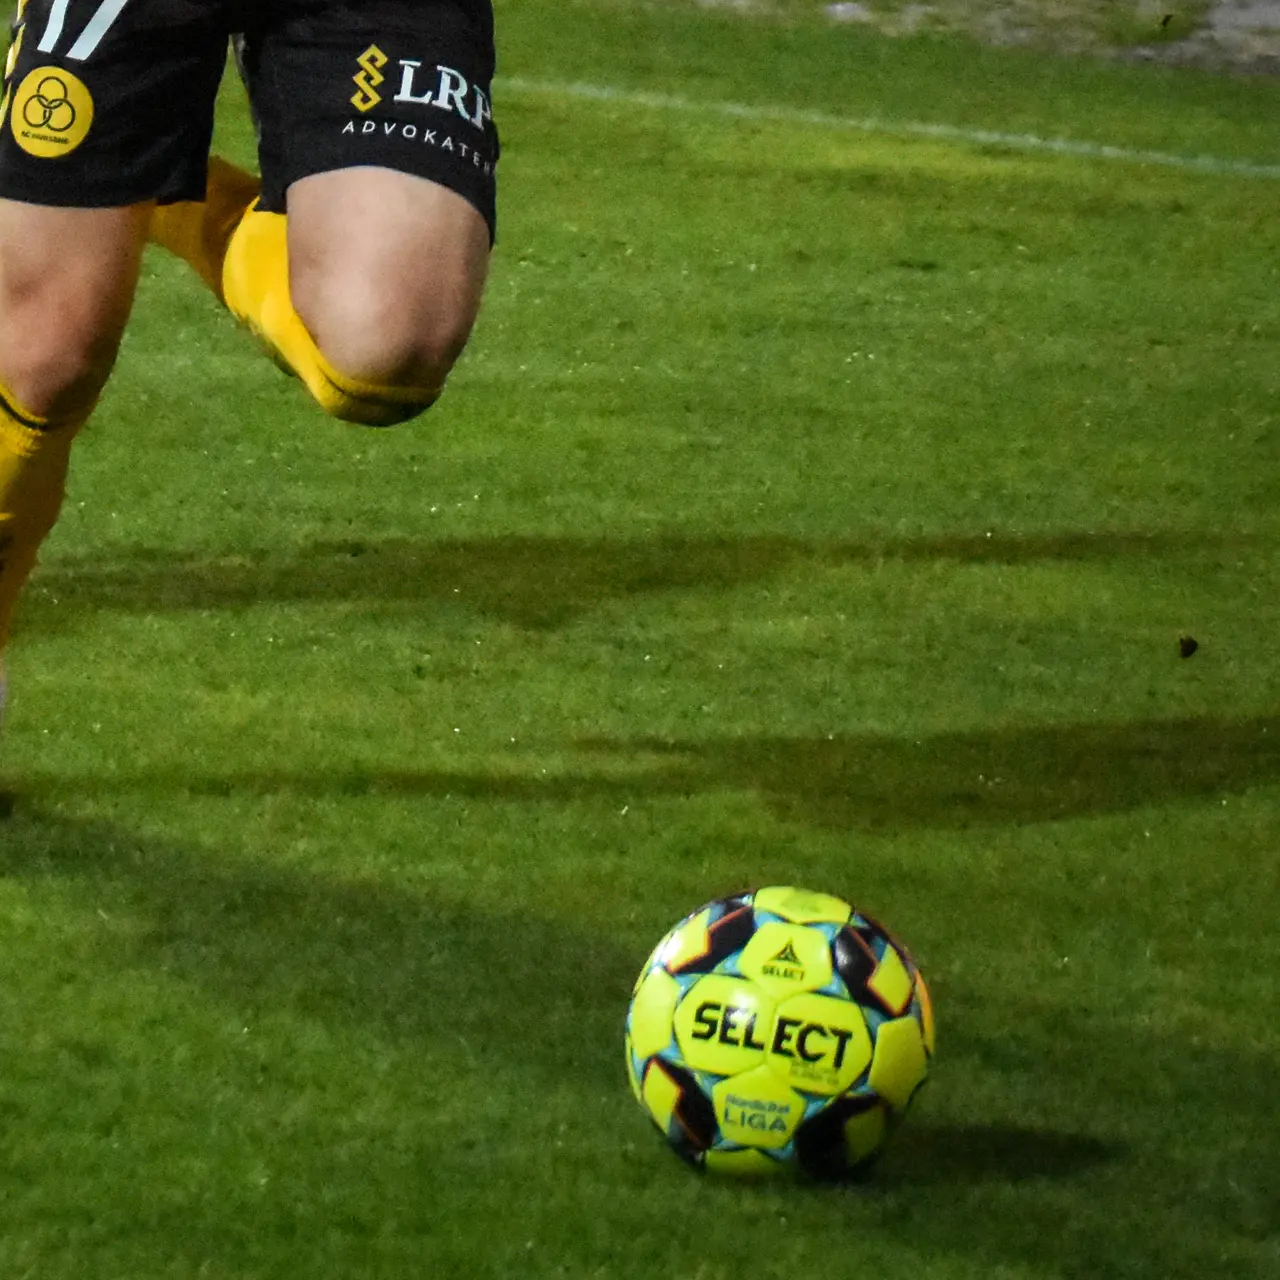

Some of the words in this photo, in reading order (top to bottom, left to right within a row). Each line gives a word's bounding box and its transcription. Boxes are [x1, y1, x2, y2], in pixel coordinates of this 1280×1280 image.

[761, 964, 805, 981] SELECT
[691, 1000, 853, 1069] SELECT
[723, 1108, 787, 1132] LIGA
